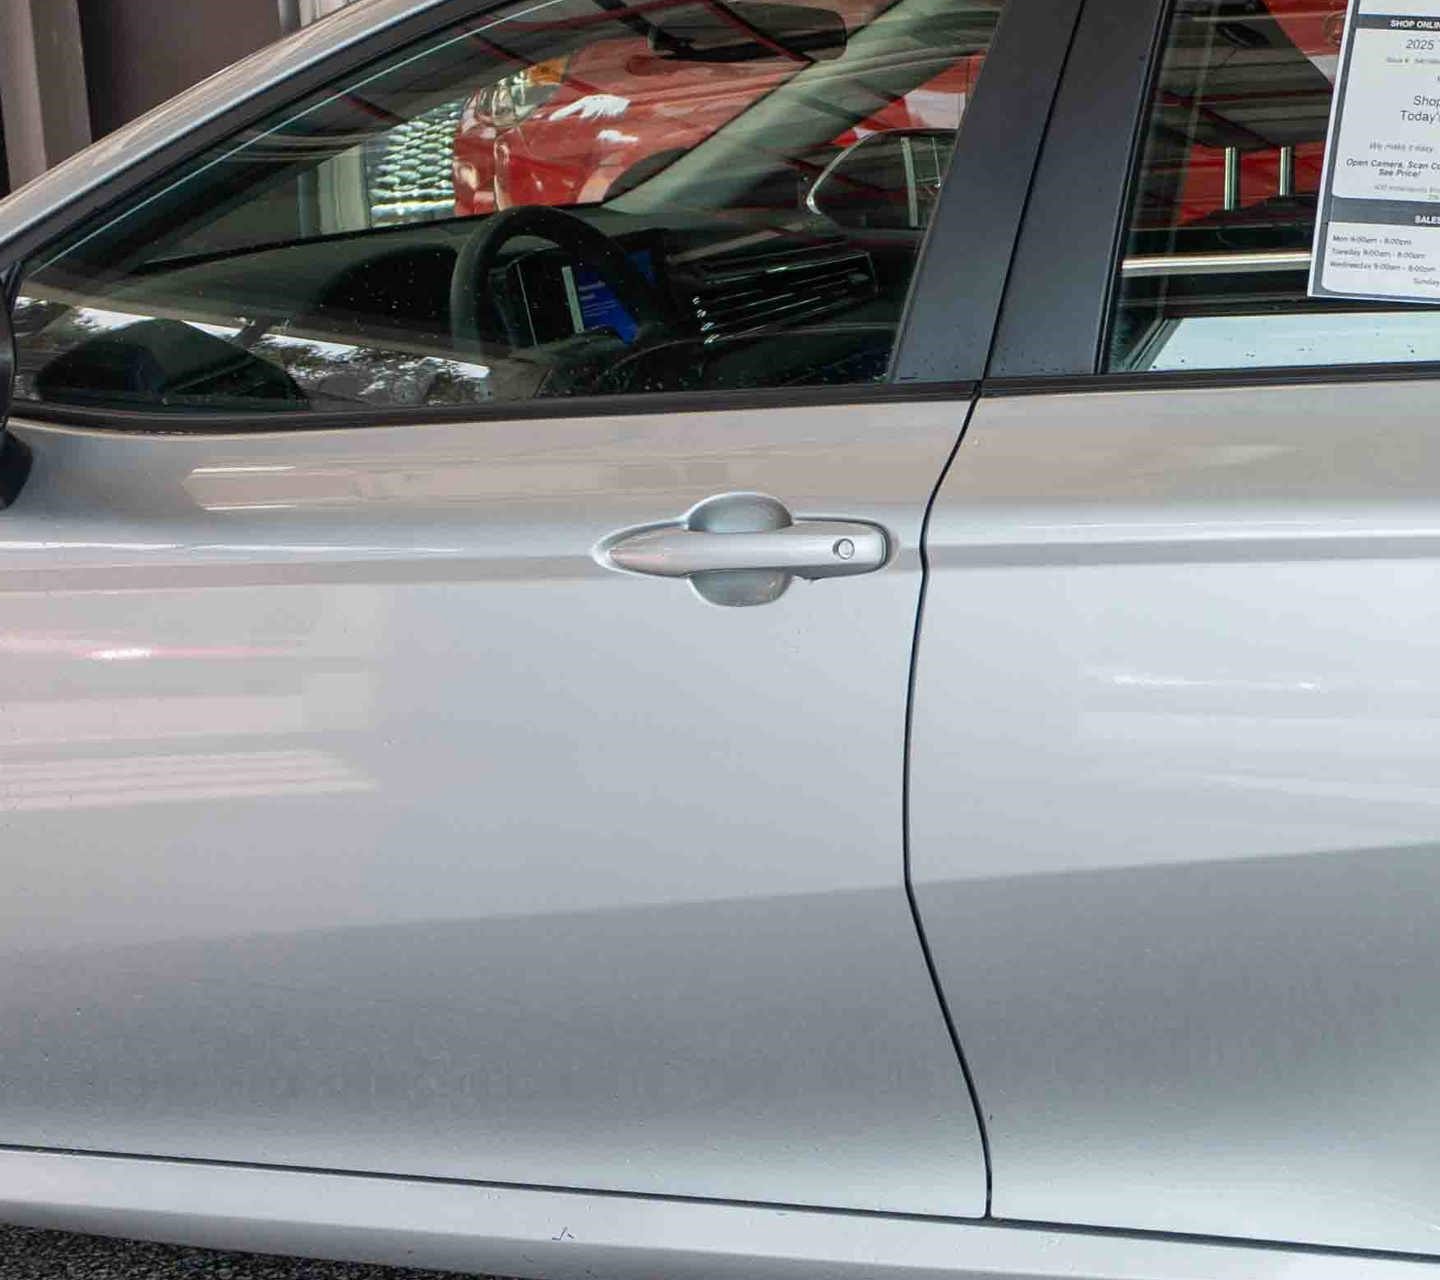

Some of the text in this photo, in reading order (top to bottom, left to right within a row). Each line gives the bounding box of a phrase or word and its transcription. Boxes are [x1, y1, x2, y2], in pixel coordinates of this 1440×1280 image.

[1390, 19, 1416, 28] SHOP
[1405, 39, 1435, 51] 2025
[1346, 158, 1369, 170] Open
[1407, 160, 1429, 170] Scan
[1378, 168, 1421, 178] See Price!
[1332, 234, 1349, 243] Mon
[1332, 248, 1362, 259] Tuesday
[1330, 261, 1373, 272] Wednesday
[1413, 277, 1440, 288] Sunday
